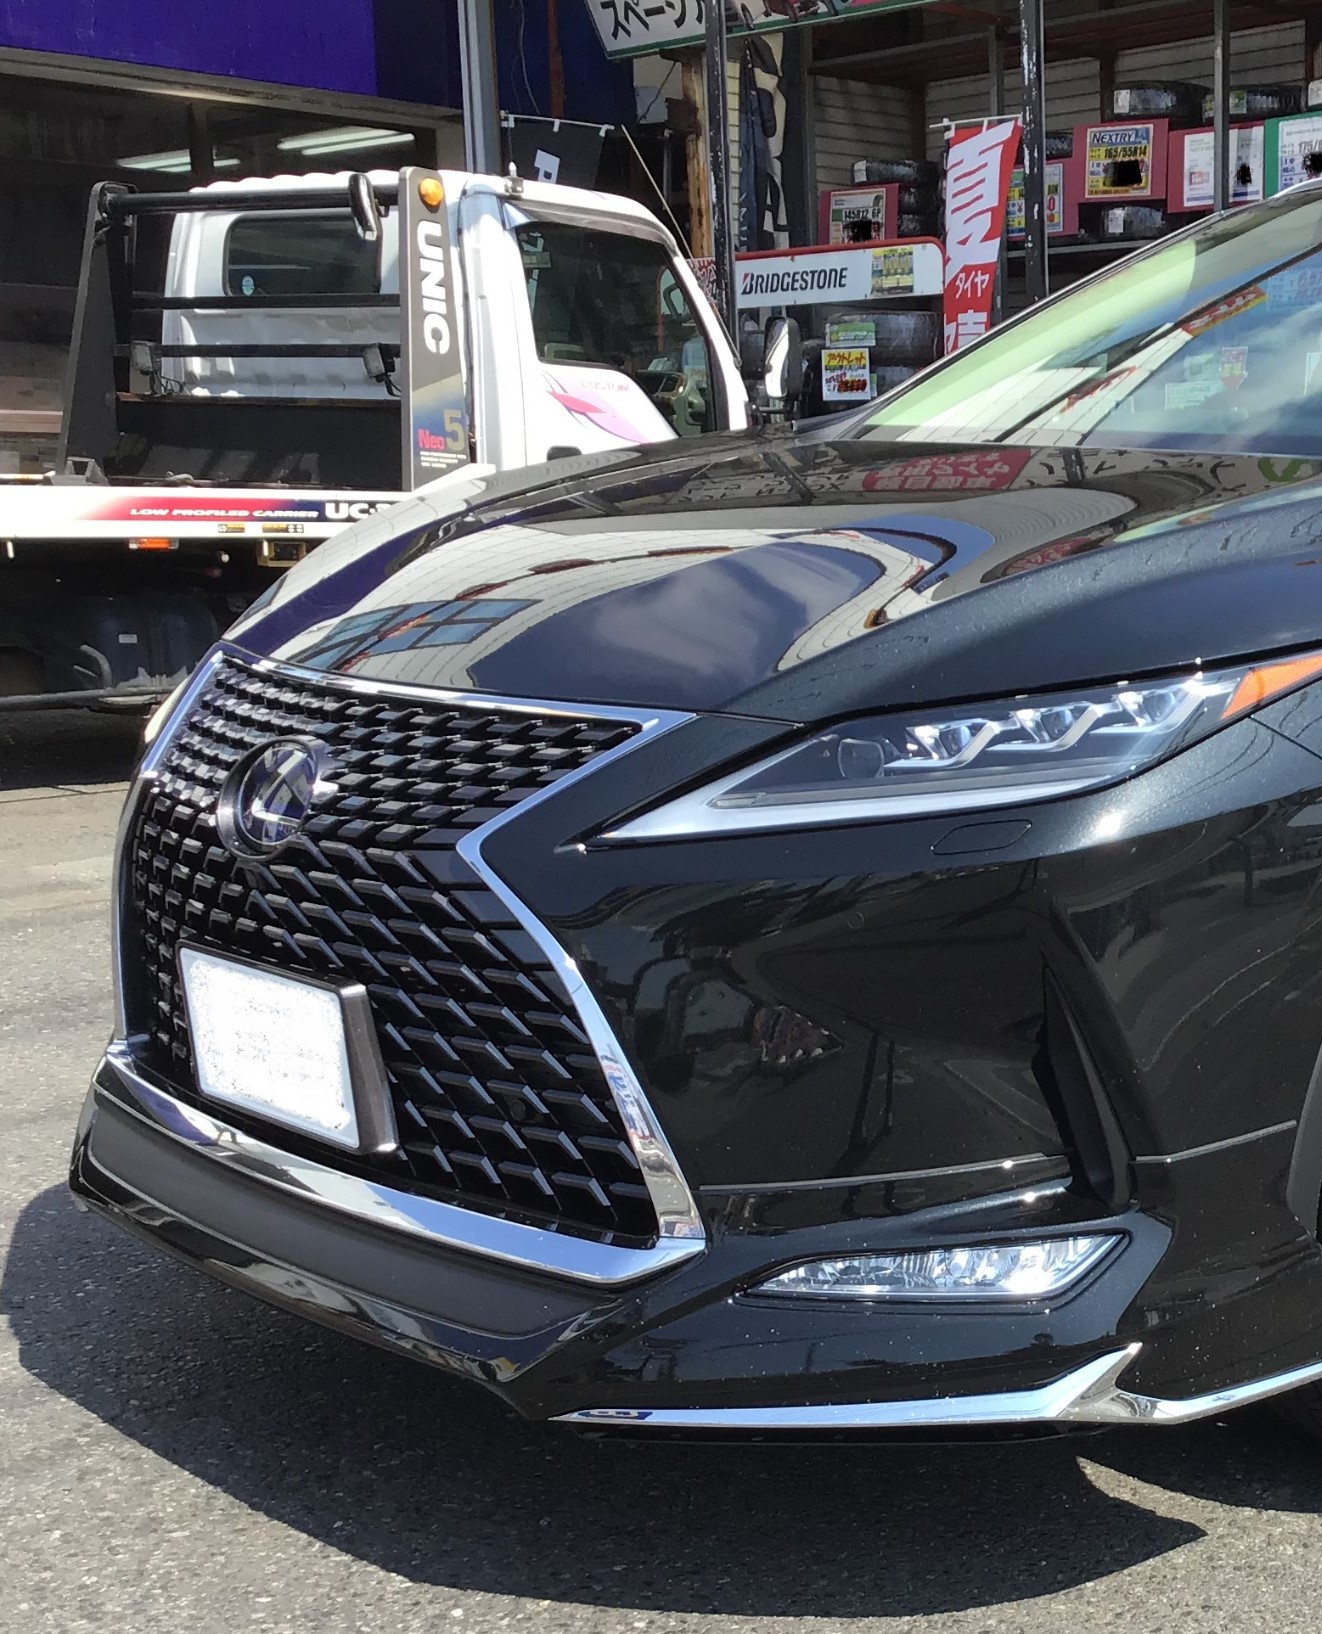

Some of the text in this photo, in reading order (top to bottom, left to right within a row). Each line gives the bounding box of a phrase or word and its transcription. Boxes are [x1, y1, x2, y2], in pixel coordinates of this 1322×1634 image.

[1092, 131, 1135, 145] NEXTRY
[1104, 145, 1148, 159] 165/55R14
[416, 219, 451, 355] UNIC
[741, 267, 848, 295] BRIDGESTONE
[955, 269, 990, 299] タイヤ
[418, 408, 465, 451] Neo 5
[129, 508, 169, 516] LOW
[172, 508, 250, 518] PROFILED
[253, 509, 320, 519] CARRIER
